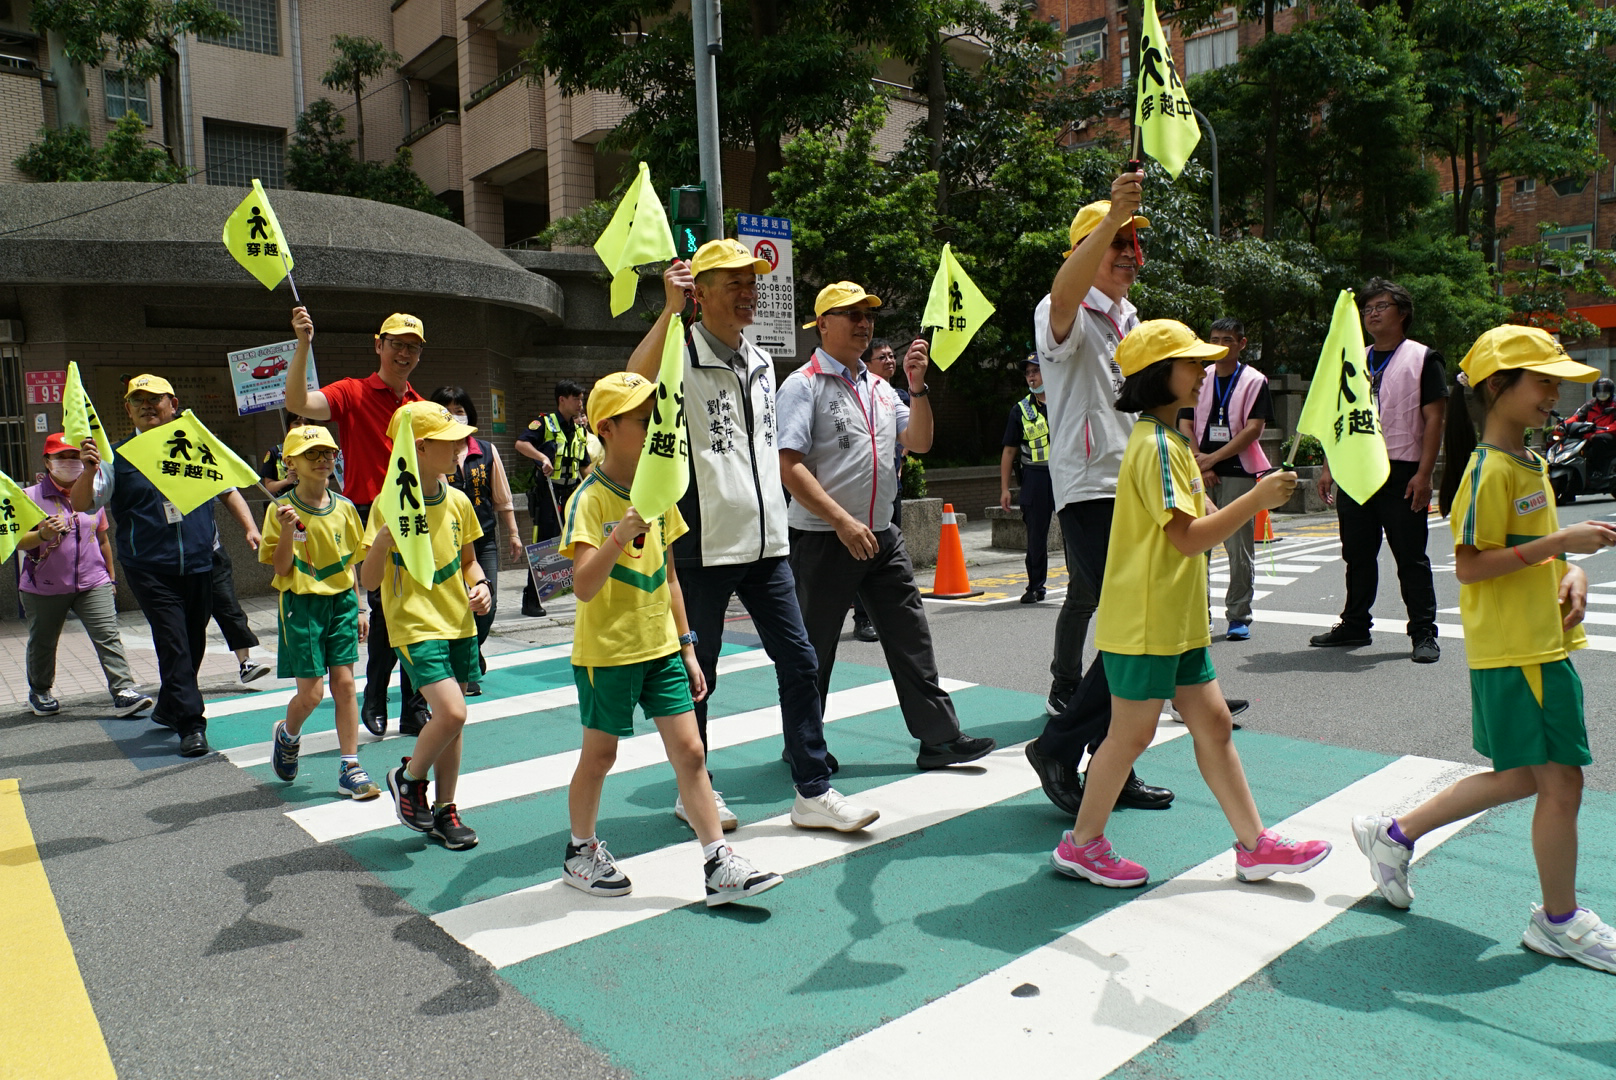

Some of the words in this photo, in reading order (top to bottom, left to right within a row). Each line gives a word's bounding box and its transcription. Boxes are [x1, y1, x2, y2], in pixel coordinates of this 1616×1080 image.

[1141, 92, 1192, 124] 穿越中
[740, 216, 789, 230] 家長接送區
[42, 385, 60, 402] 95
[706, 399, 725, 454] 劉安祺
[829, 401, 850, 449] 張新福
[643, 431, 687, 462] 越中
[162, 460, 224, 482] 穿越中
